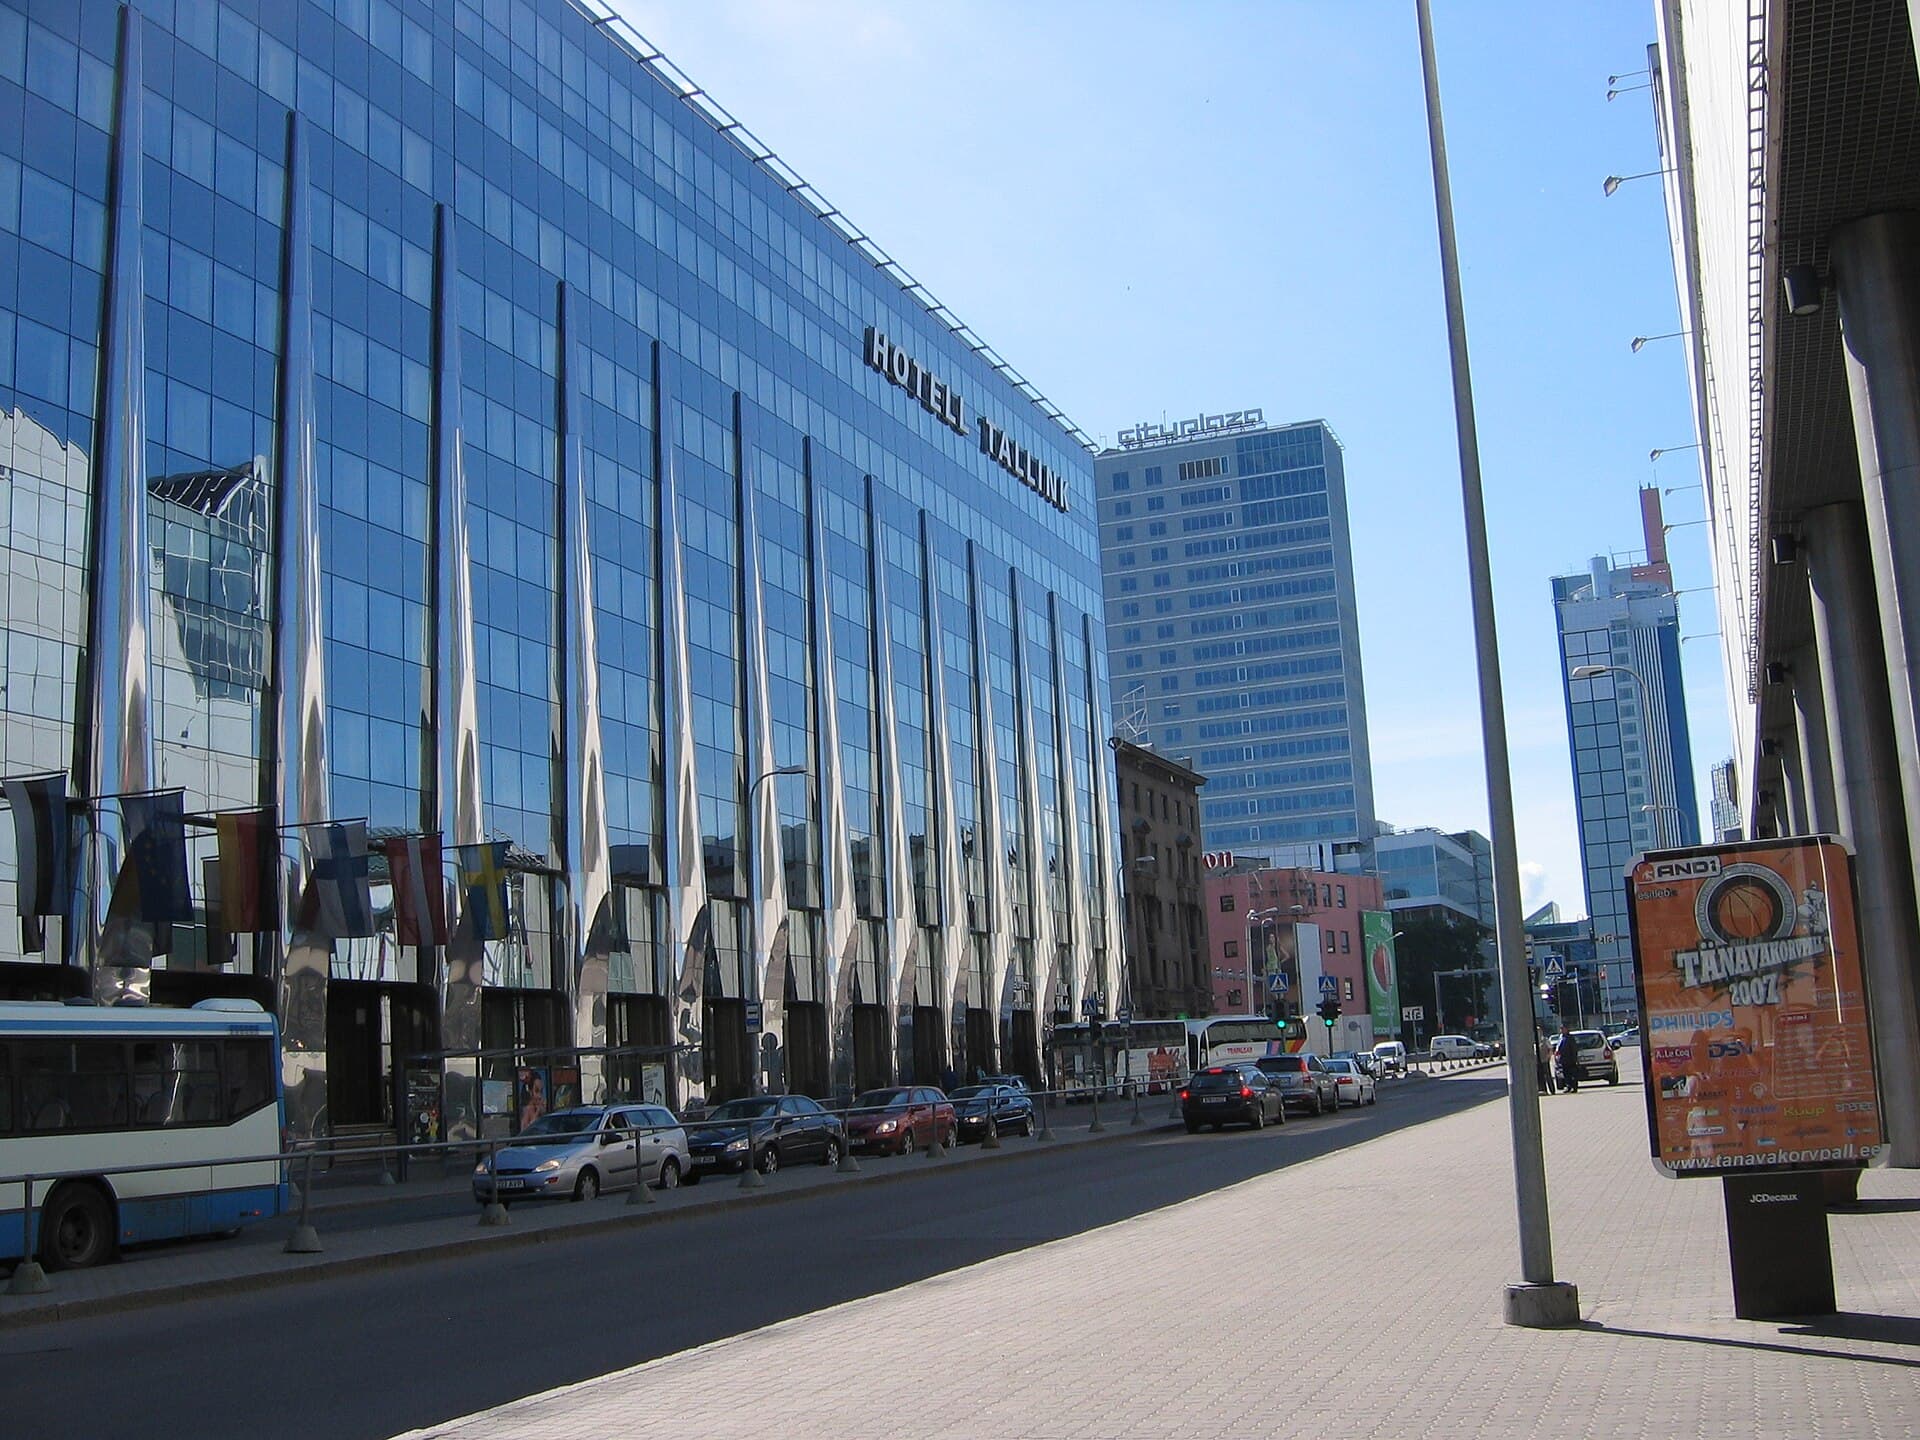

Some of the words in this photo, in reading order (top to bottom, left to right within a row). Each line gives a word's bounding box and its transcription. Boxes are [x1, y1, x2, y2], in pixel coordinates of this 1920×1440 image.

[868, 328, 970, 436] HOTELL
[983, 419, 1070, 513] TALLINK
[1118, 408, 1263, 444] cityplaza
[1657, 860, 1717, 878] AND1
[1676, 937, 1825, 987] TÄNAVAKORVPALL
[1729, 974, 1780, 1006] 2007
[1651, 1009, 1735, 1031] PHILIPS
[1666, 1144, 1881, 1169] www.tanavakorvpall.ee
[1750, 1193, 1799, 1203] JCDecaux
